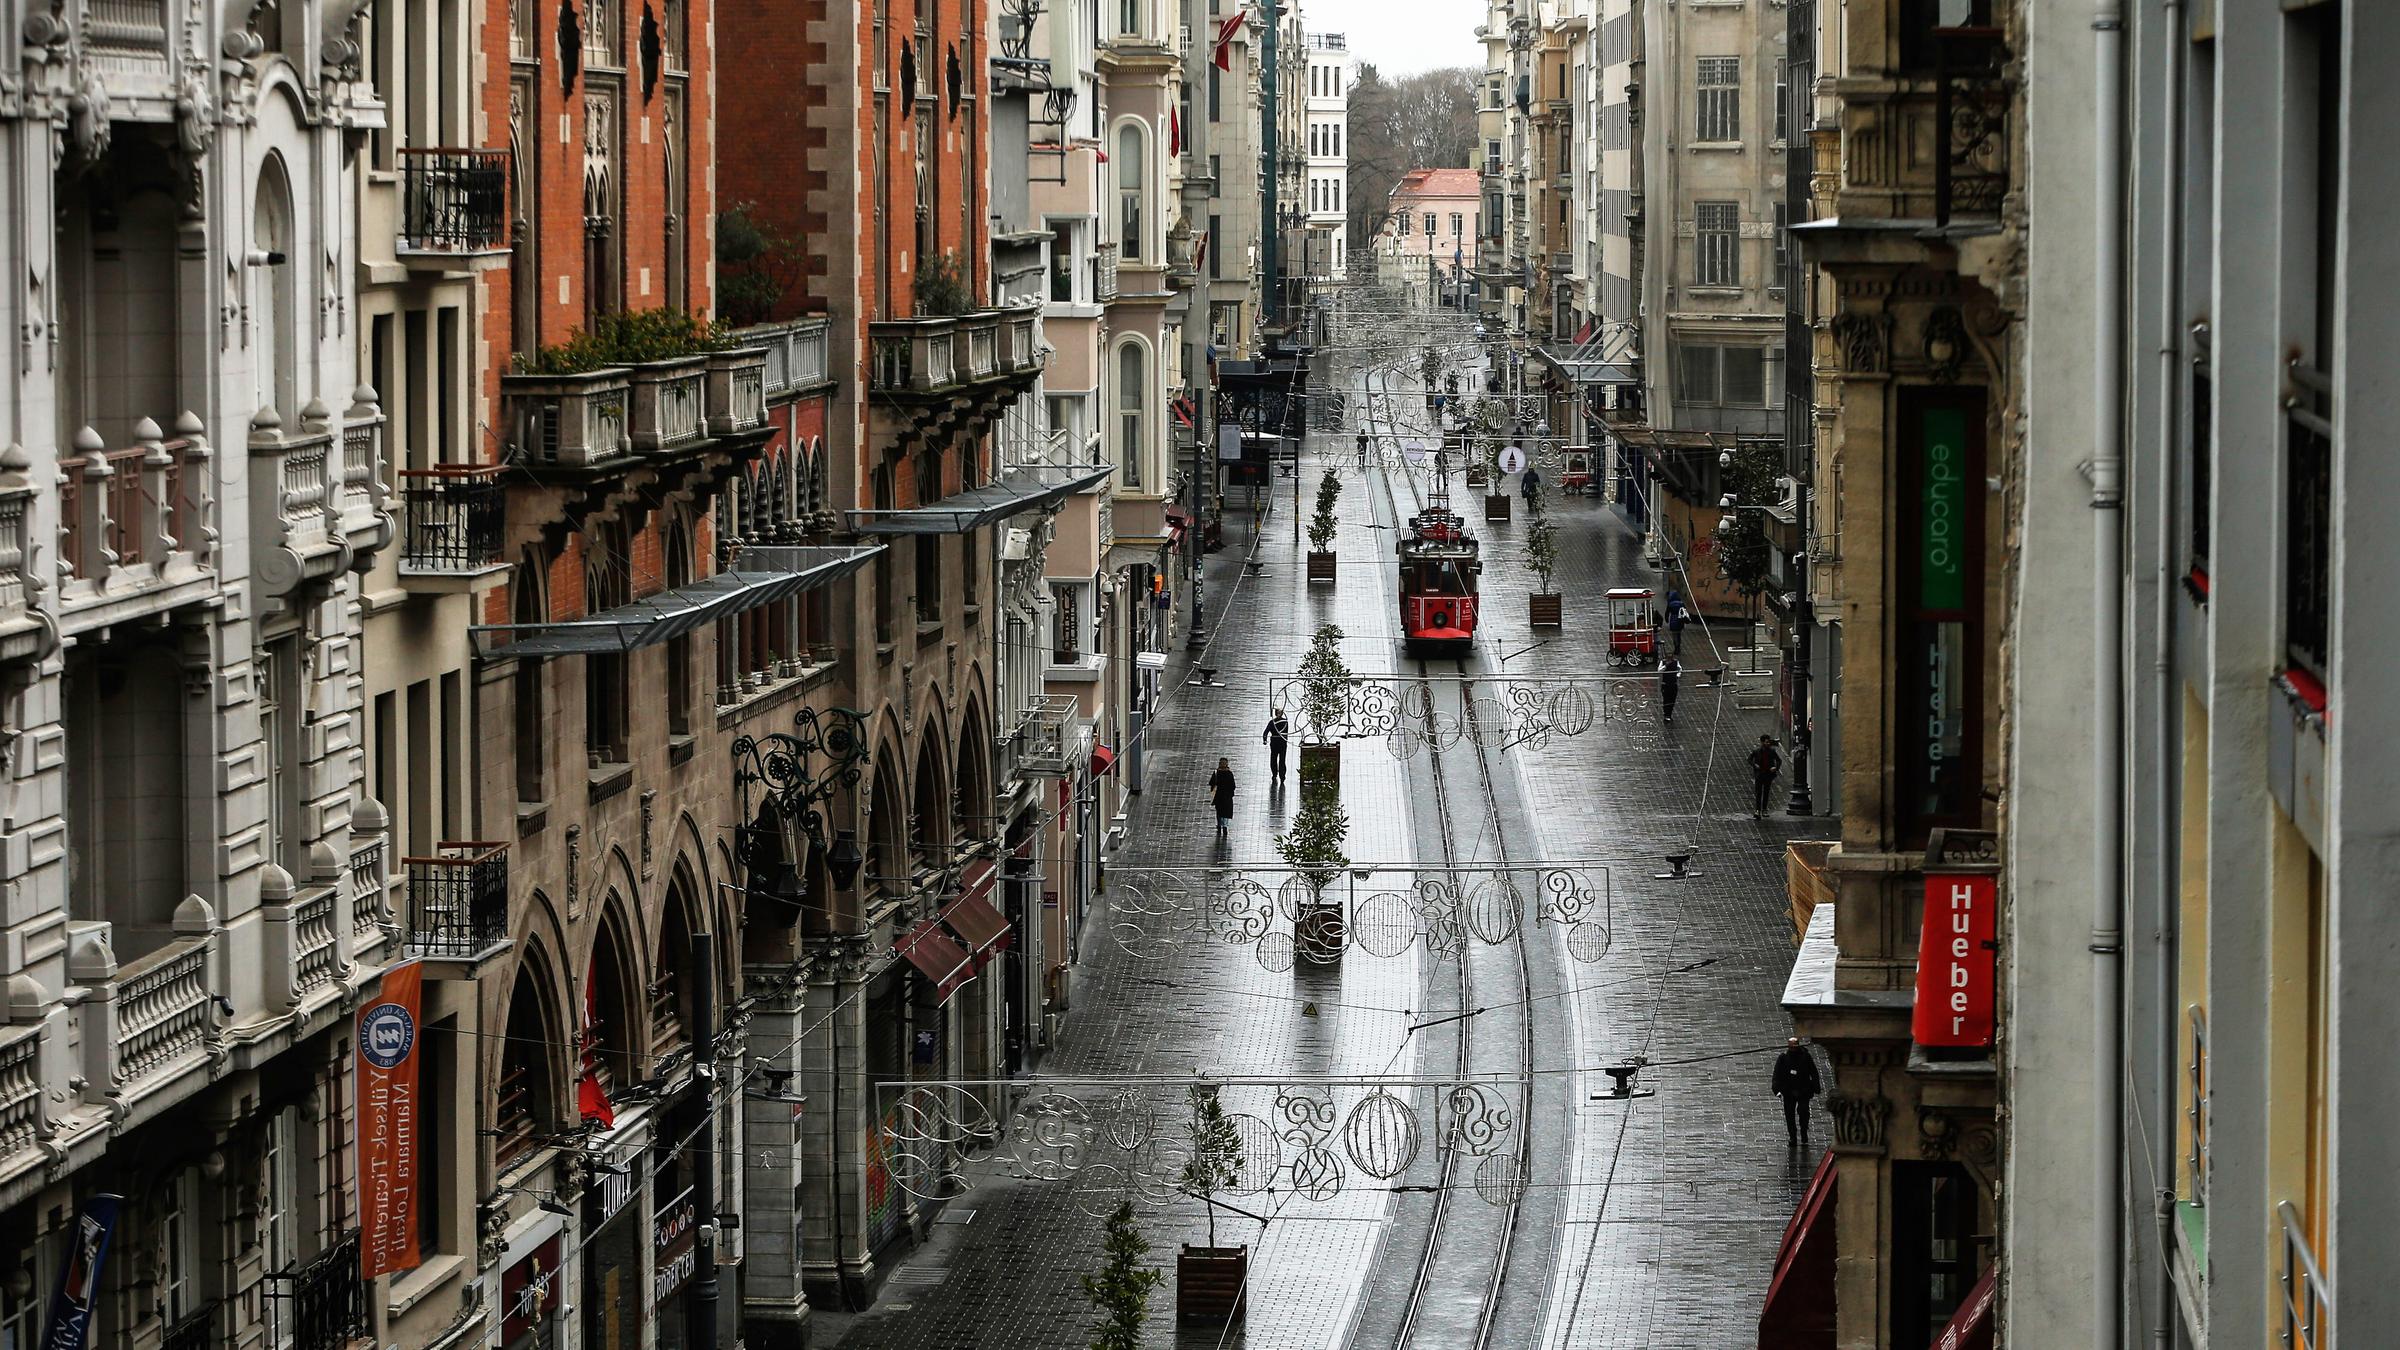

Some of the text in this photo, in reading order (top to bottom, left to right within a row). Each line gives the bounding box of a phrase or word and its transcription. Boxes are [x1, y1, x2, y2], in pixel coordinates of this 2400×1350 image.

[1930, 444, 1960, 567] educaro
[1929, 643, 1947, 783] Hueber
[1950, 884, 1972, 1036] Hueber
